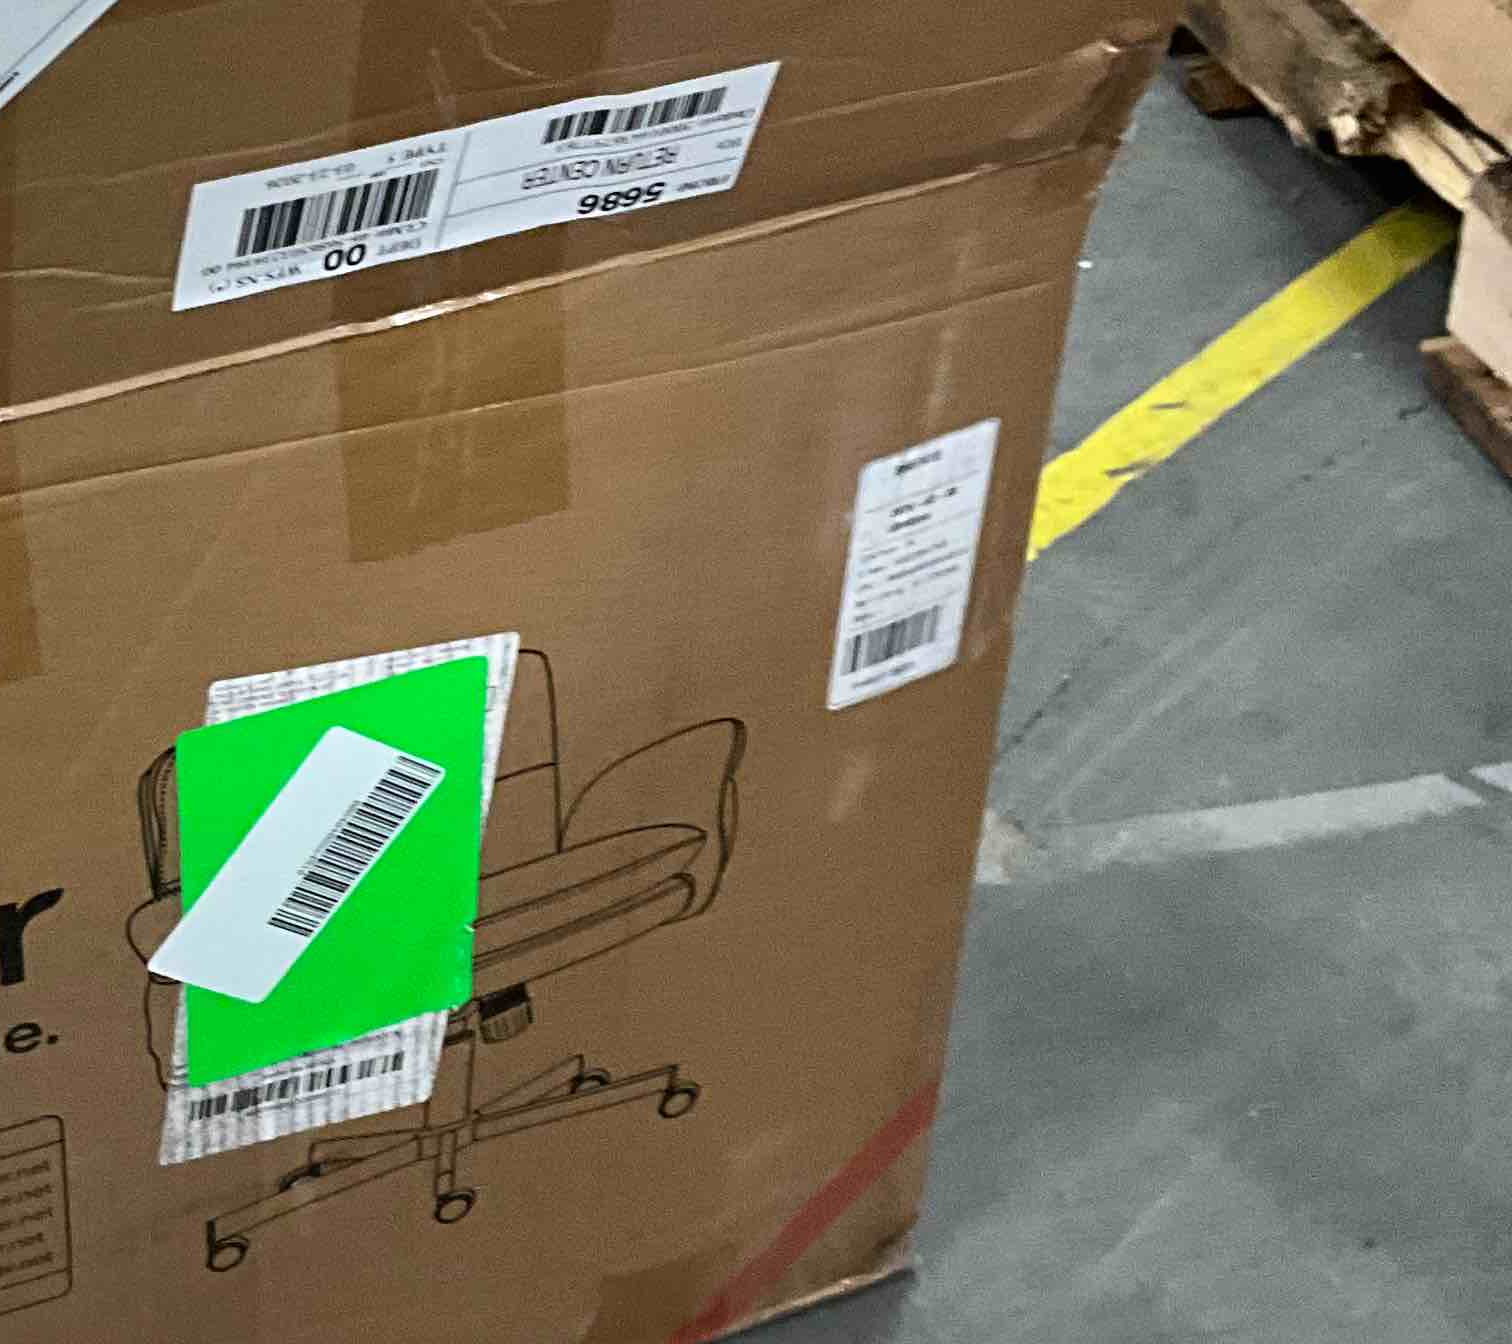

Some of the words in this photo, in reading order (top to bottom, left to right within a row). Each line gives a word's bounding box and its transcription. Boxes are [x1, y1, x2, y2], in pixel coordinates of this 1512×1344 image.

[520, 159, 600, 191] CENTER
[599, 145, 680, 178] RETURN
[576, 181, 666, 216] 5686
[323, 243, 366, 271] 00
